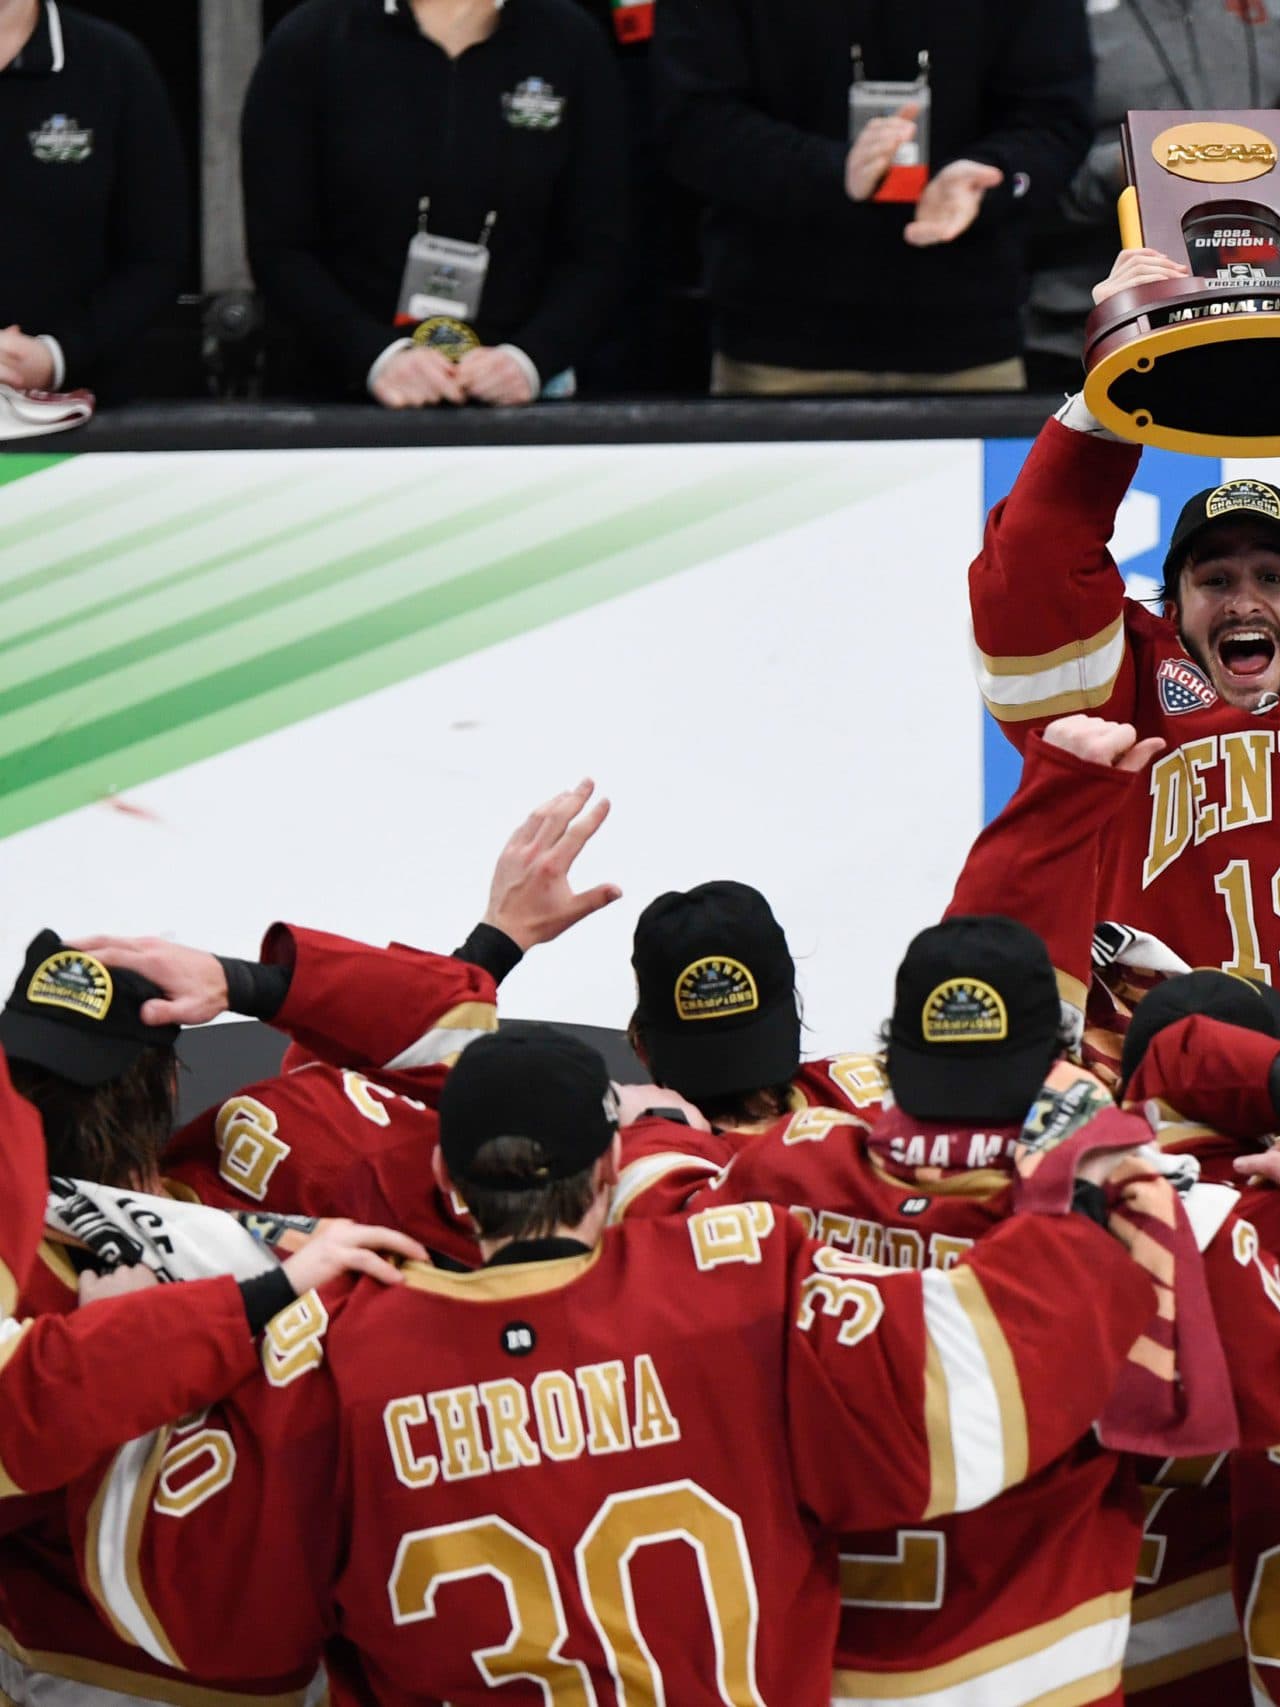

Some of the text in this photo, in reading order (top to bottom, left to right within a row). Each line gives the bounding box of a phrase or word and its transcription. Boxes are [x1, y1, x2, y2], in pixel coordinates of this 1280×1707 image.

[1166, 142, 1276, 167] NCAA
[1194, 237, 1264, 248] DIVISION
[1207, 279, 1250, 288] FROZEN
[1168, 299, 1258, 323] NATIONAL
[1158, 661, 1218, 704] NCHC
[383, 1353, 681, 1490] CHRONA
[387, 1478, 767, 1707] 30
